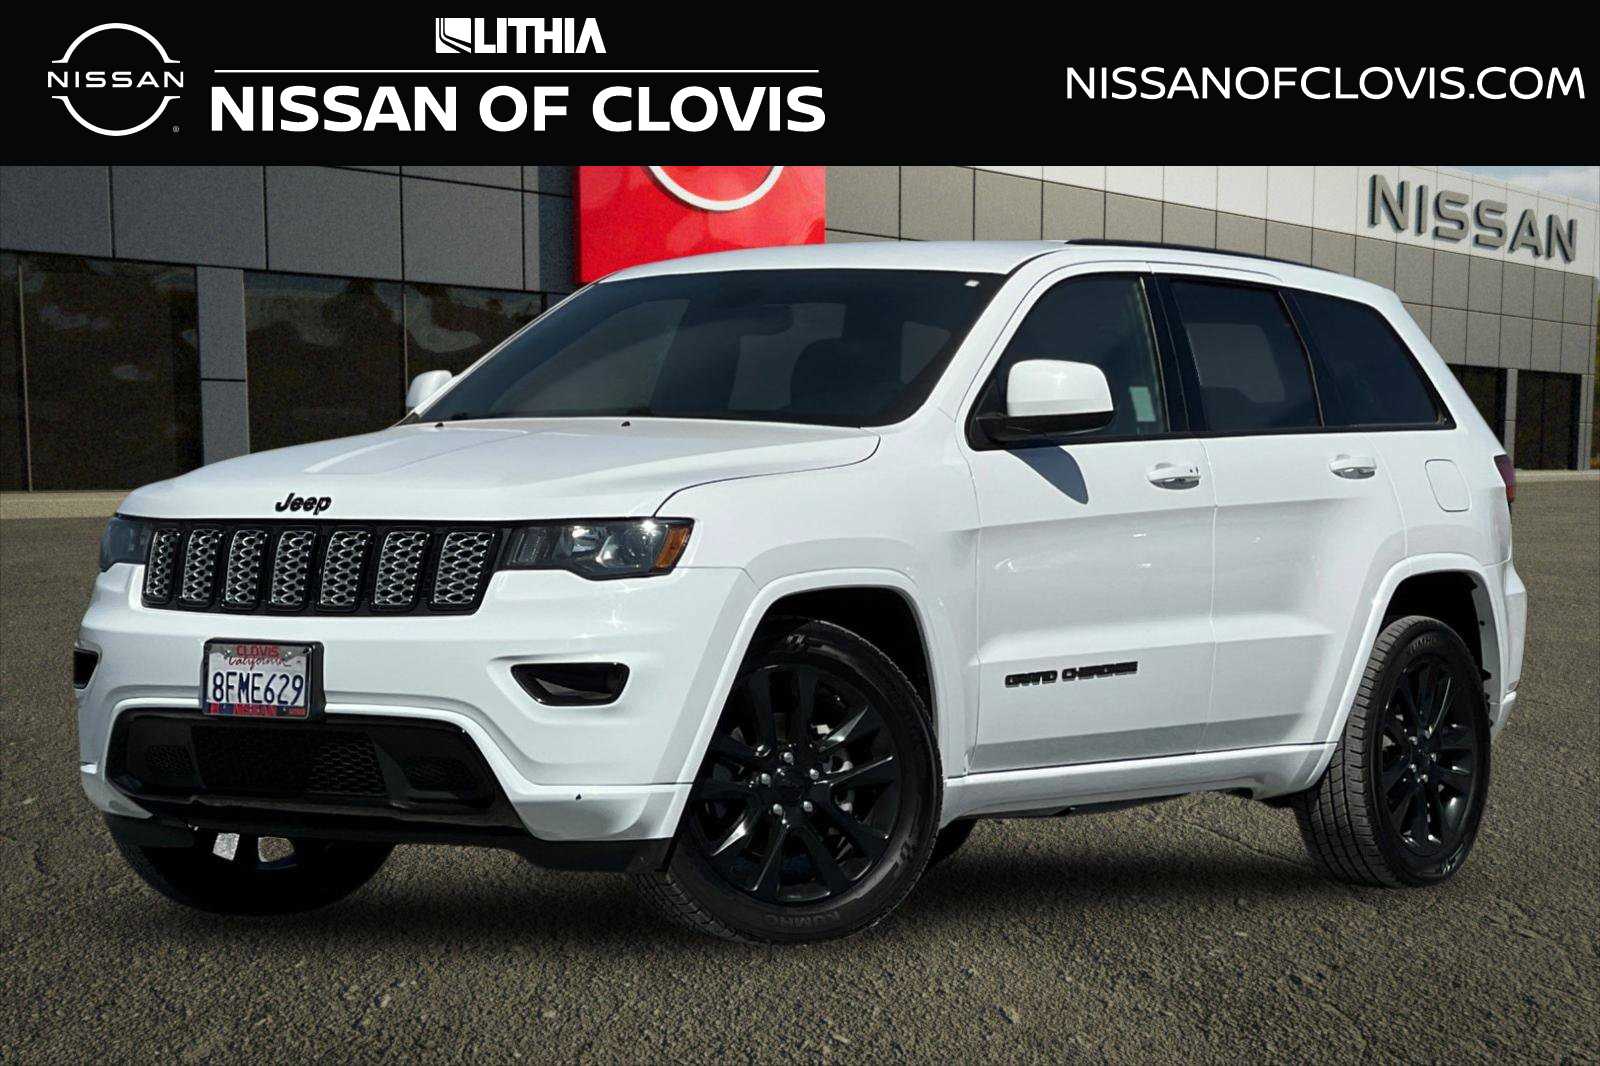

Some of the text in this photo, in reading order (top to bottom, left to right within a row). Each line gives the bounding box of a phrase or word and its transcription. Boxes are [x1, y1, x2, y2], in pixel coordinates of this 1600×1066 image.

[1367, 174, 1577, 263] NISSAN
[276, 492, 331, 515] Jeep
[236, 645, 279, 656] CLOVIS
[212, 671, 304, 705] 8FME629
